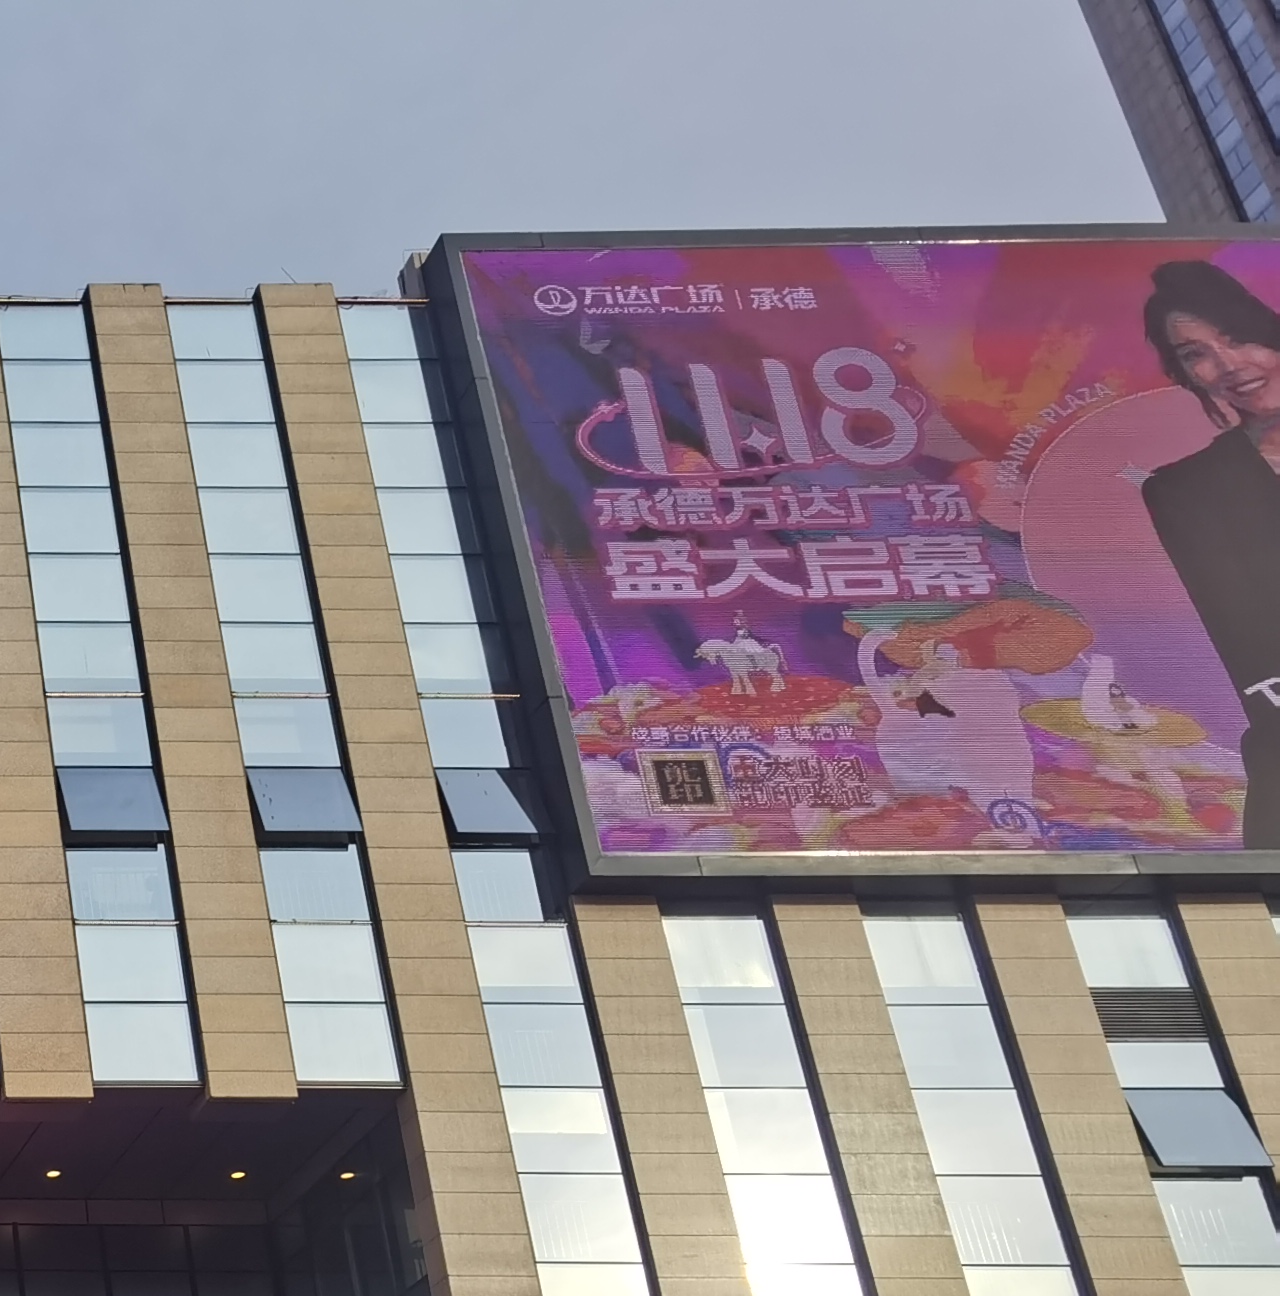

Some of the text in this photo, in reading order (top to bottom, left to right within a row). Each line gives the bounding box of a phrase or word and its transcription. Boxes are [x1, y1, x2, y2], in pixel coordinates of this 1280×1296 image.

[578, 284, 818, 310] 万达广场 承德
[1040, 382, 1116, 424] PLAZA
[593, 485, 973, 525] 承德万达广场
[603, 534, 996, 600] 盛大启幕
